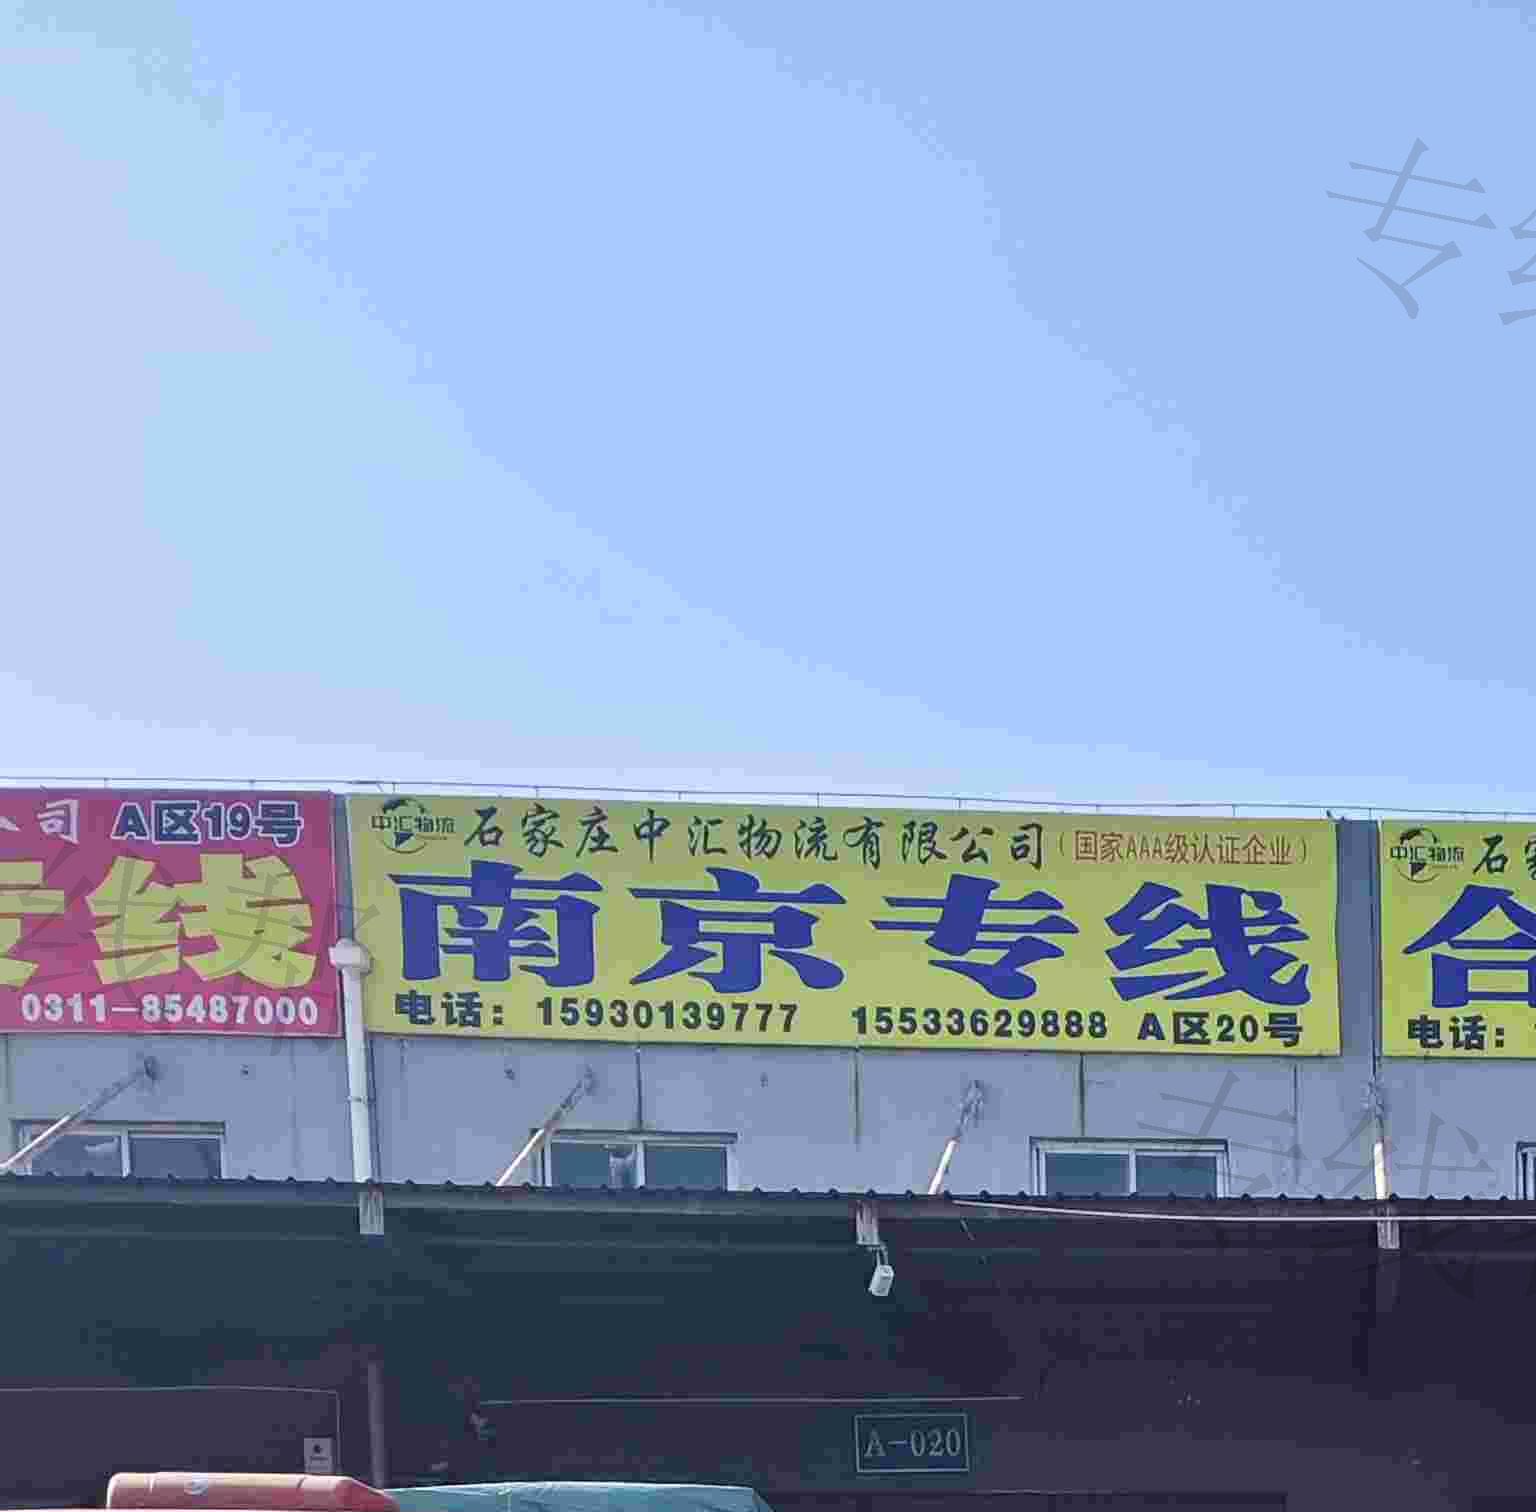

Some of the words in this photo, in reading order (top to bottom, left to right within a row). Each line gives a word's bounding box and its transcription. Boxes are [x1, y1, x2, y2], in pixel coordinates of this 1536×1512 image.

[0, 800, 80, 845] 司
[111, 800, 304, 847] A区19号
[464, 802, 1043, 870] 石家庄中汇物流有限公司
[387, 859, 1312, 1004] 南京专线
[537, 998, 799, 1033] 15930139777
[851, 1005, 1107, 1039] 15533629888
[1137, 1011, 1303, 1047] A区20号
[864, 1427, 961, 1457] A-020
